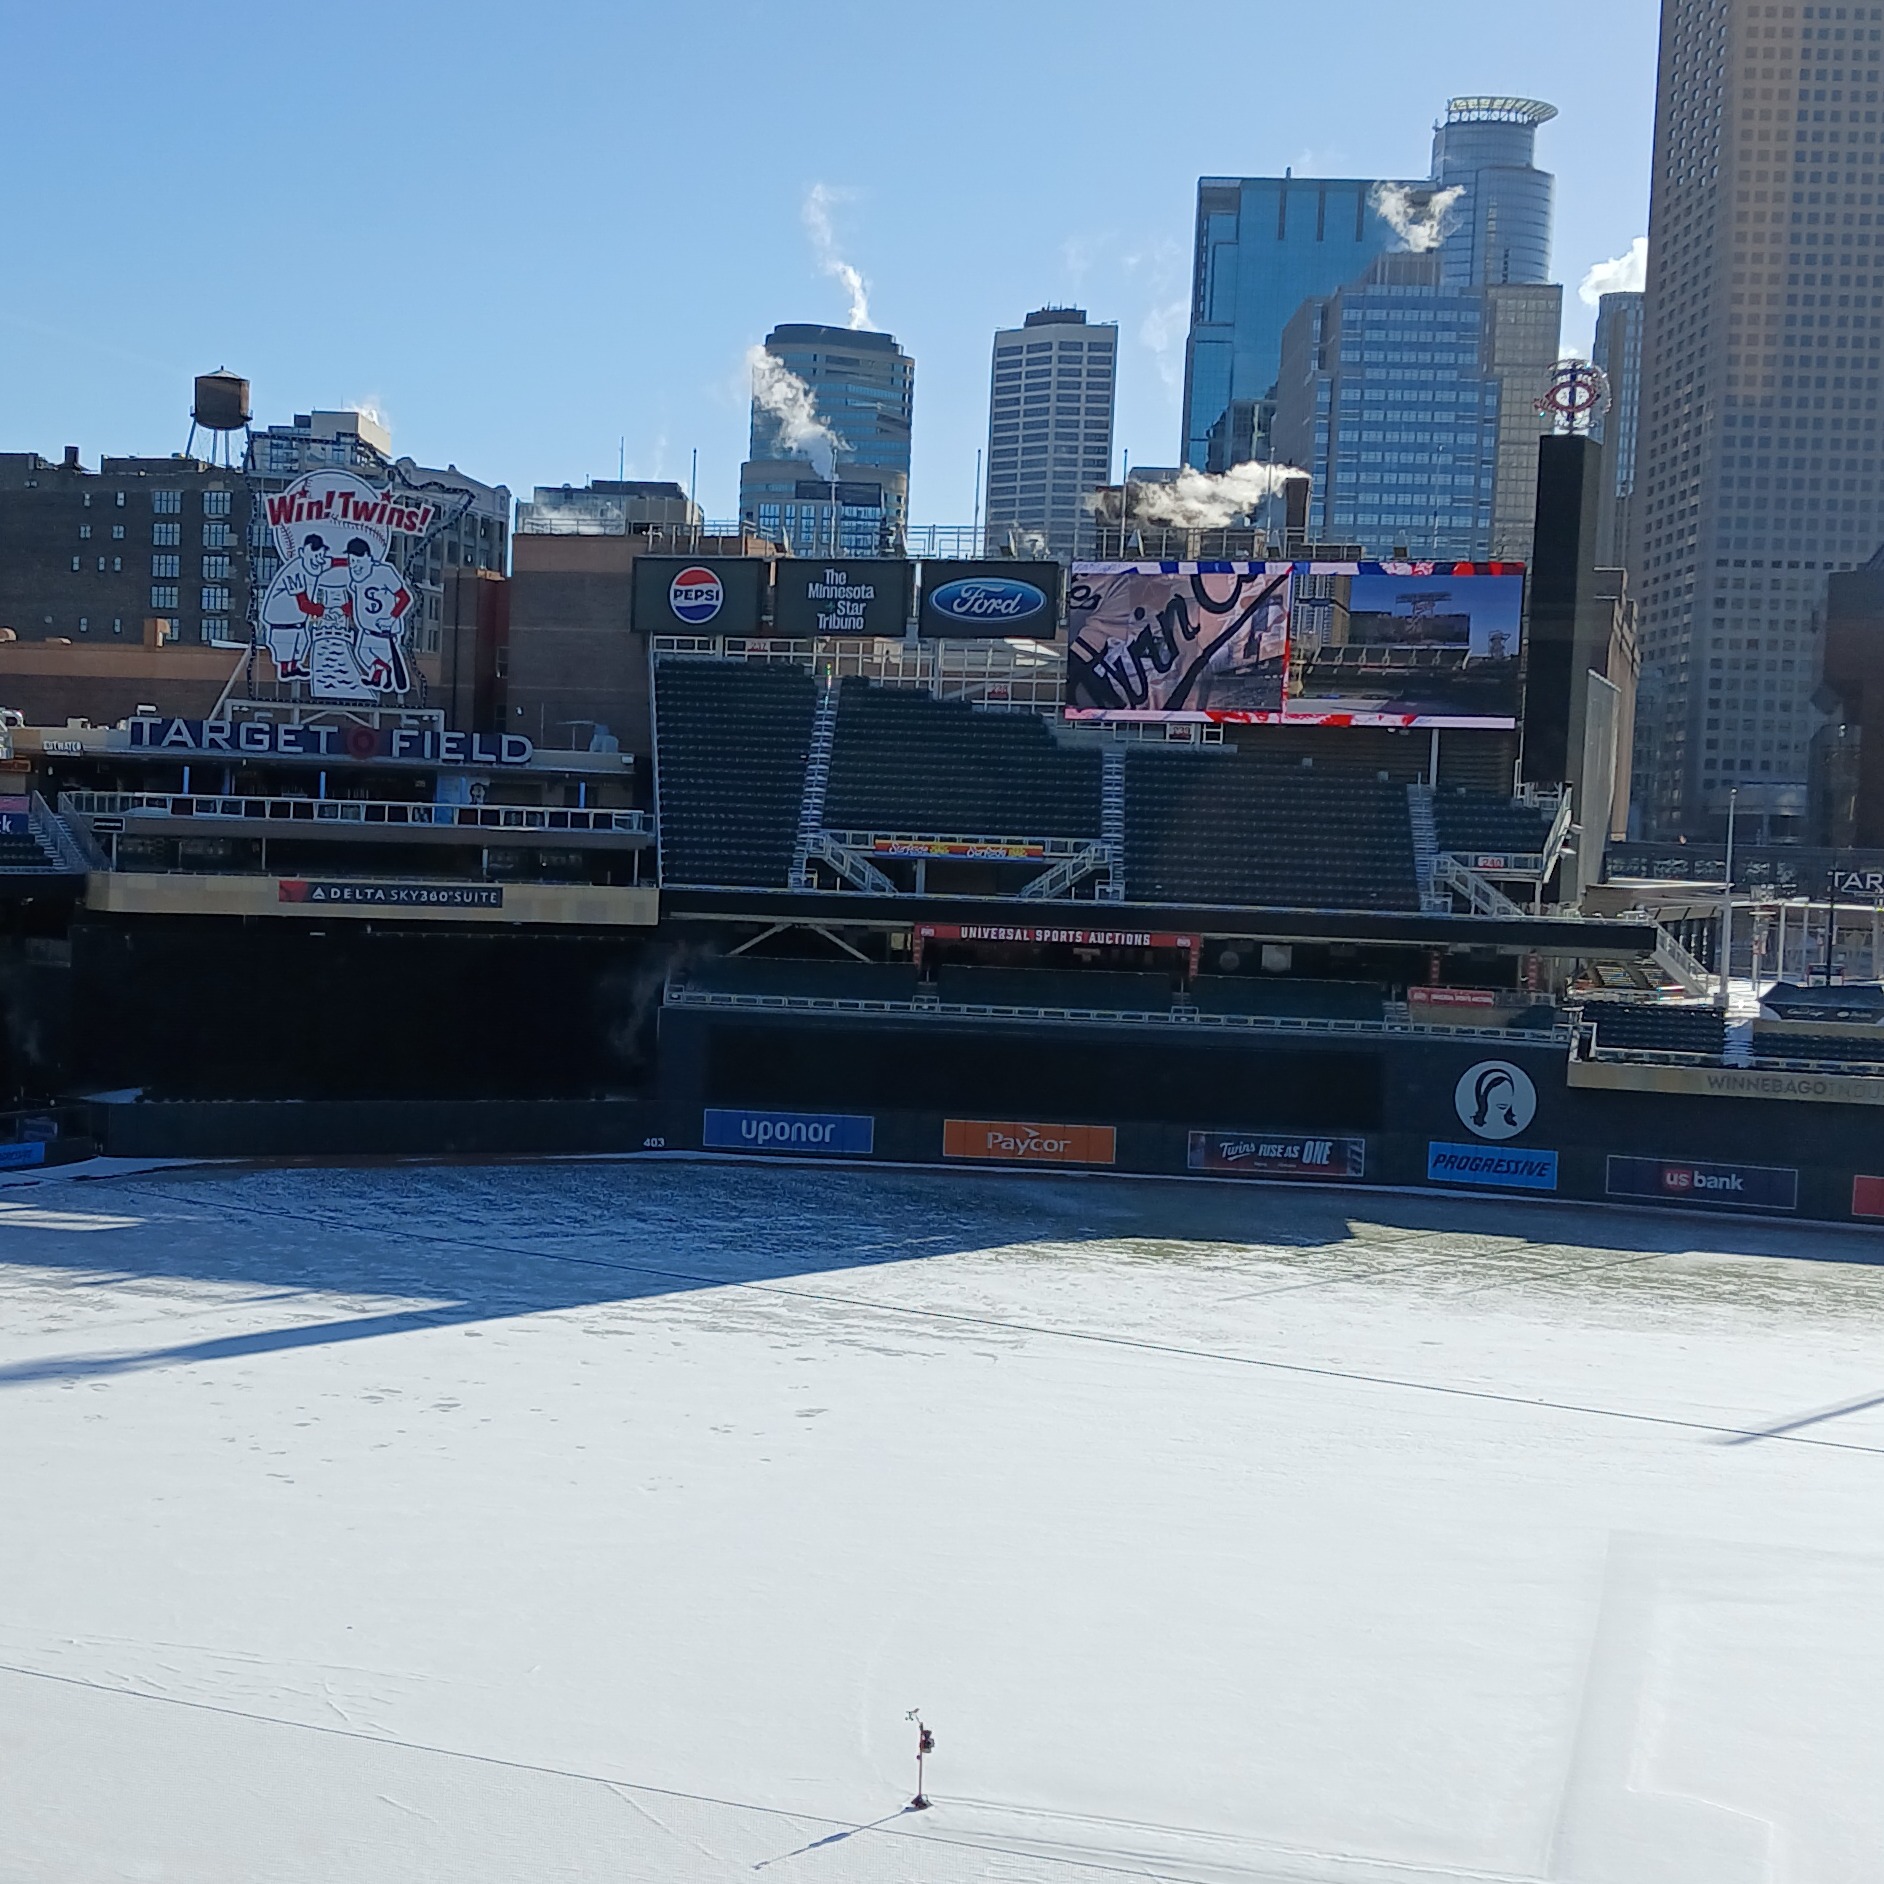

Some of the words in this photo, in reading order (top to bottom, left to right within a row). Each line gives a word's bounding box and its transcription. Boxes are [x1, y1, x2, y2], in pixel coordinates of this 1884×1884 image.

[267, 489, 335, 526] Win!
[338, 490, 434, 534] Twins!
[823, 568, 847, 585] The
[673, 588, 720, 602] PEPSI
[807, 582, 875, 599] Minnesota
[952, 583, 1023, 614] Ford
[836, 600, 867, 616] Star
[816, 612, 865, 630] Tribune
[128, 716, 339, 756] TARGET
[390, 728, 534, 764] FIELD
[330, 886, 386, 901] DELTA
[453, 891, 498, 904] SUITE
[960, 926, 1030, 941] UNIVERSAL
[1035, 929, 1083, 944] SPORTS
[1088, 931, 1151, 946] AUCTIONS
[1706, 1074, 1829, 1095] WINNEBAGO
[741, 1118, 836, 1145] uponor
[643, 1137, 665, 1148] 403
[986, 1131, 1071, 1155] Paycor
[1220, 1141, 1256, 1160] Twins
[1302, 1140, 1333, 1165] ONE
[1432, 1153, 1551, 1179] PROGRESSIVE
